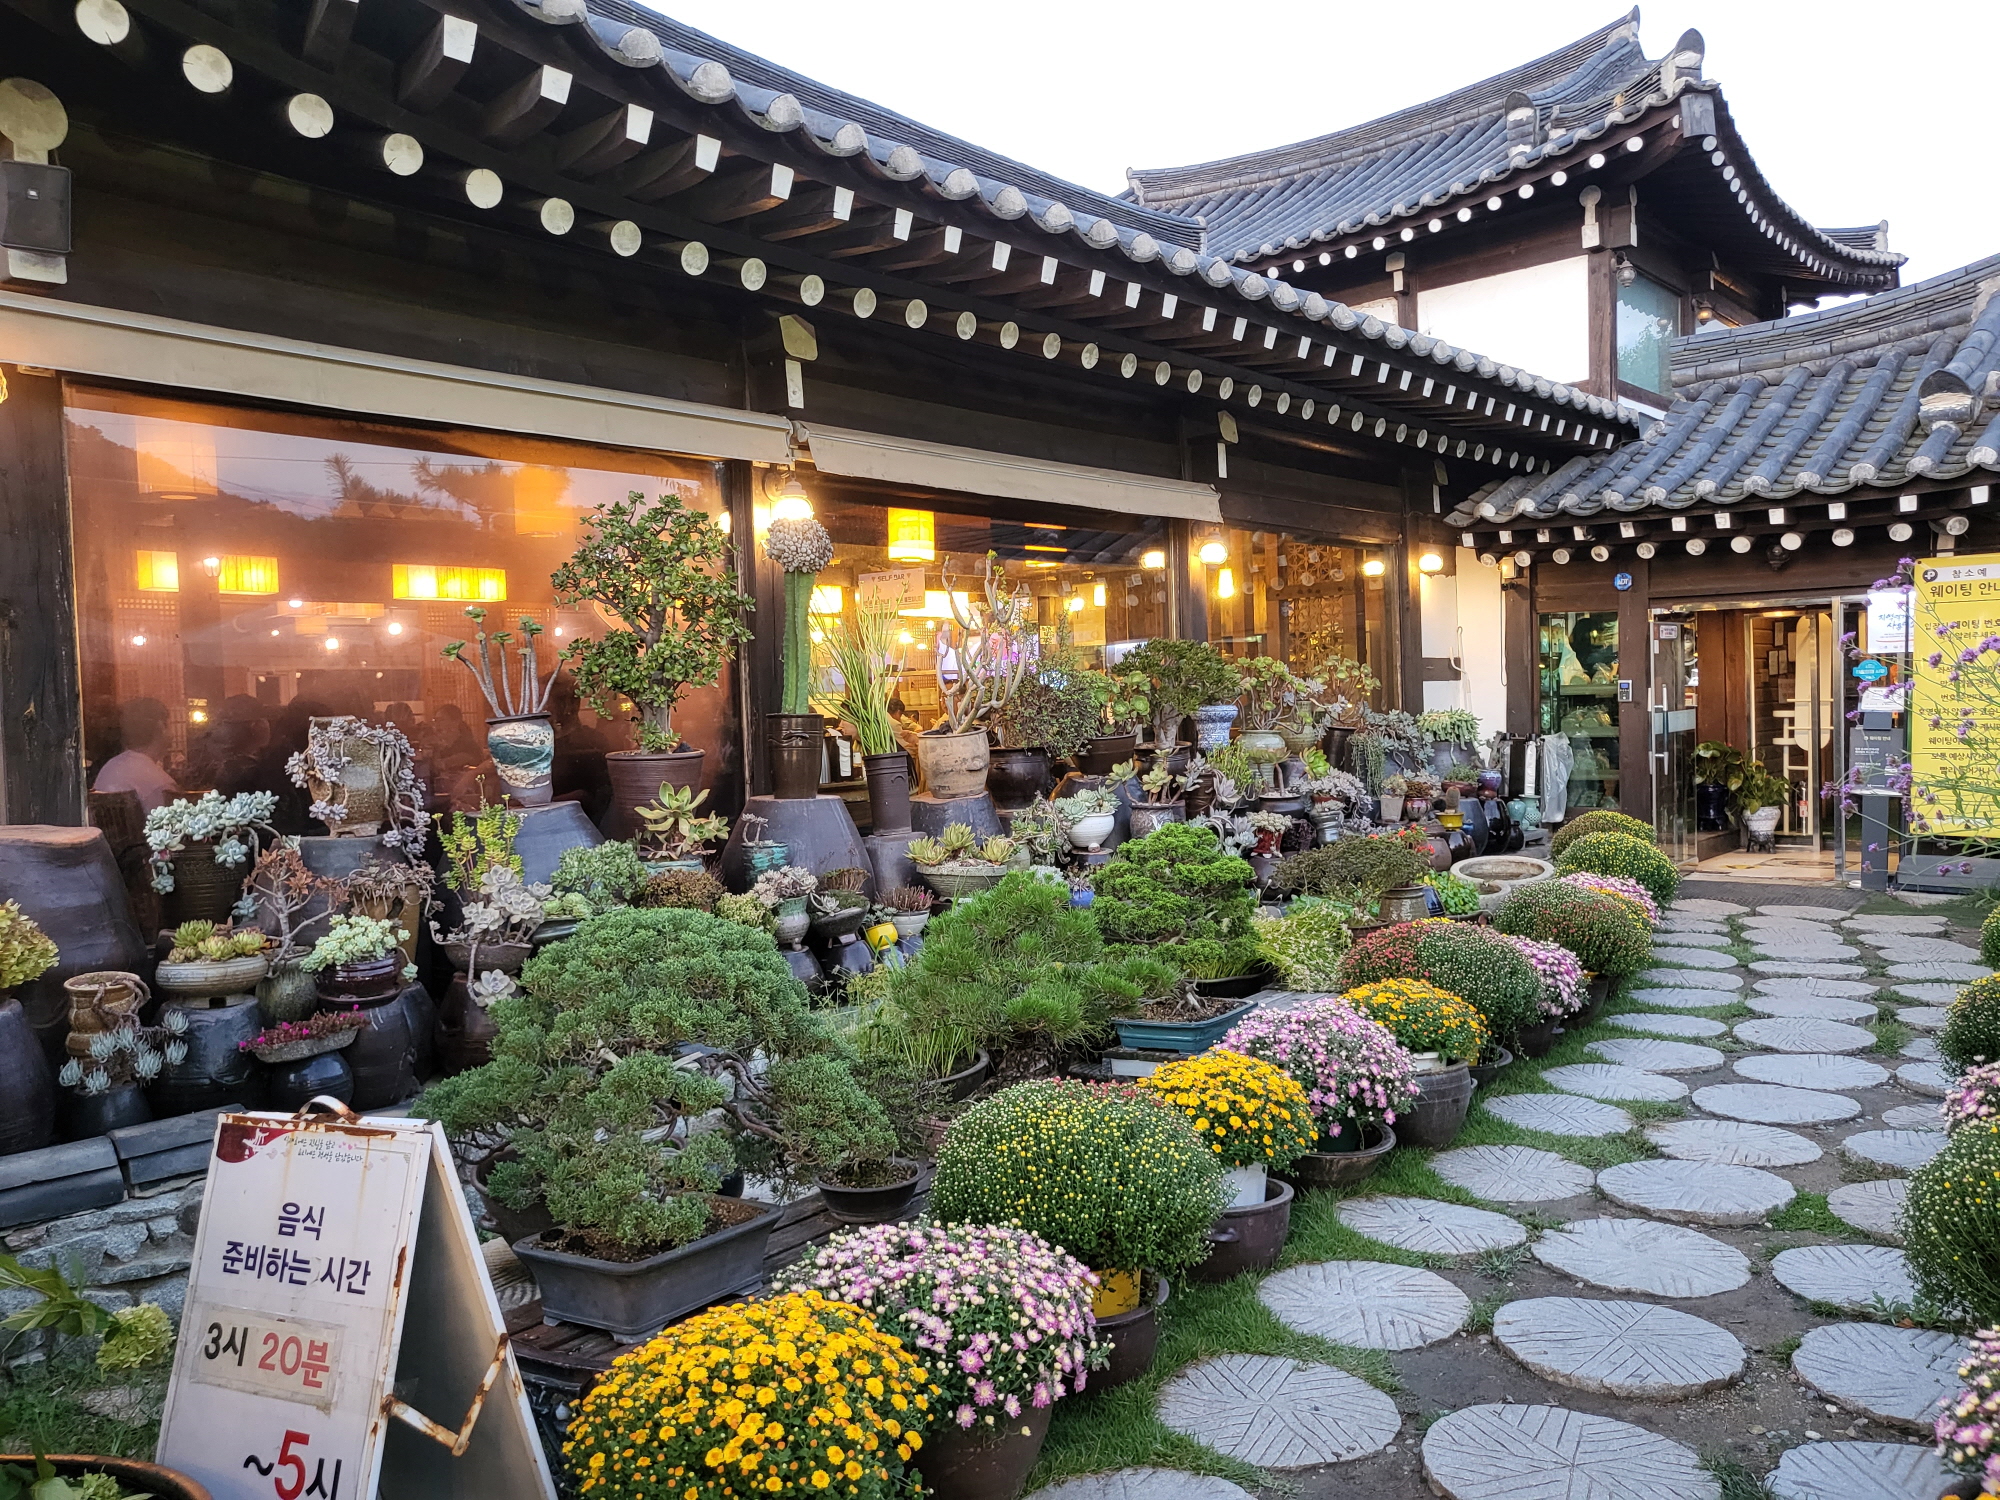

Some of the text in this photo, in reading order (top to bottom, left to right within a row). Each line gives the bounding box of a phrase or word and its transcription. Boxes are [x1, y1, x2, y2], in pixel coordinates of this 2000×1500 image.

[1930, 583, 1972, 598] 웨이팅
[278, 1202, 325, 1241] 음식
[222, 1240, 371, 1296] 준비하는 시간
[204, 1322, 330, 1389] 3시 20분
[243, 1429, 342, 1500] ~5시
